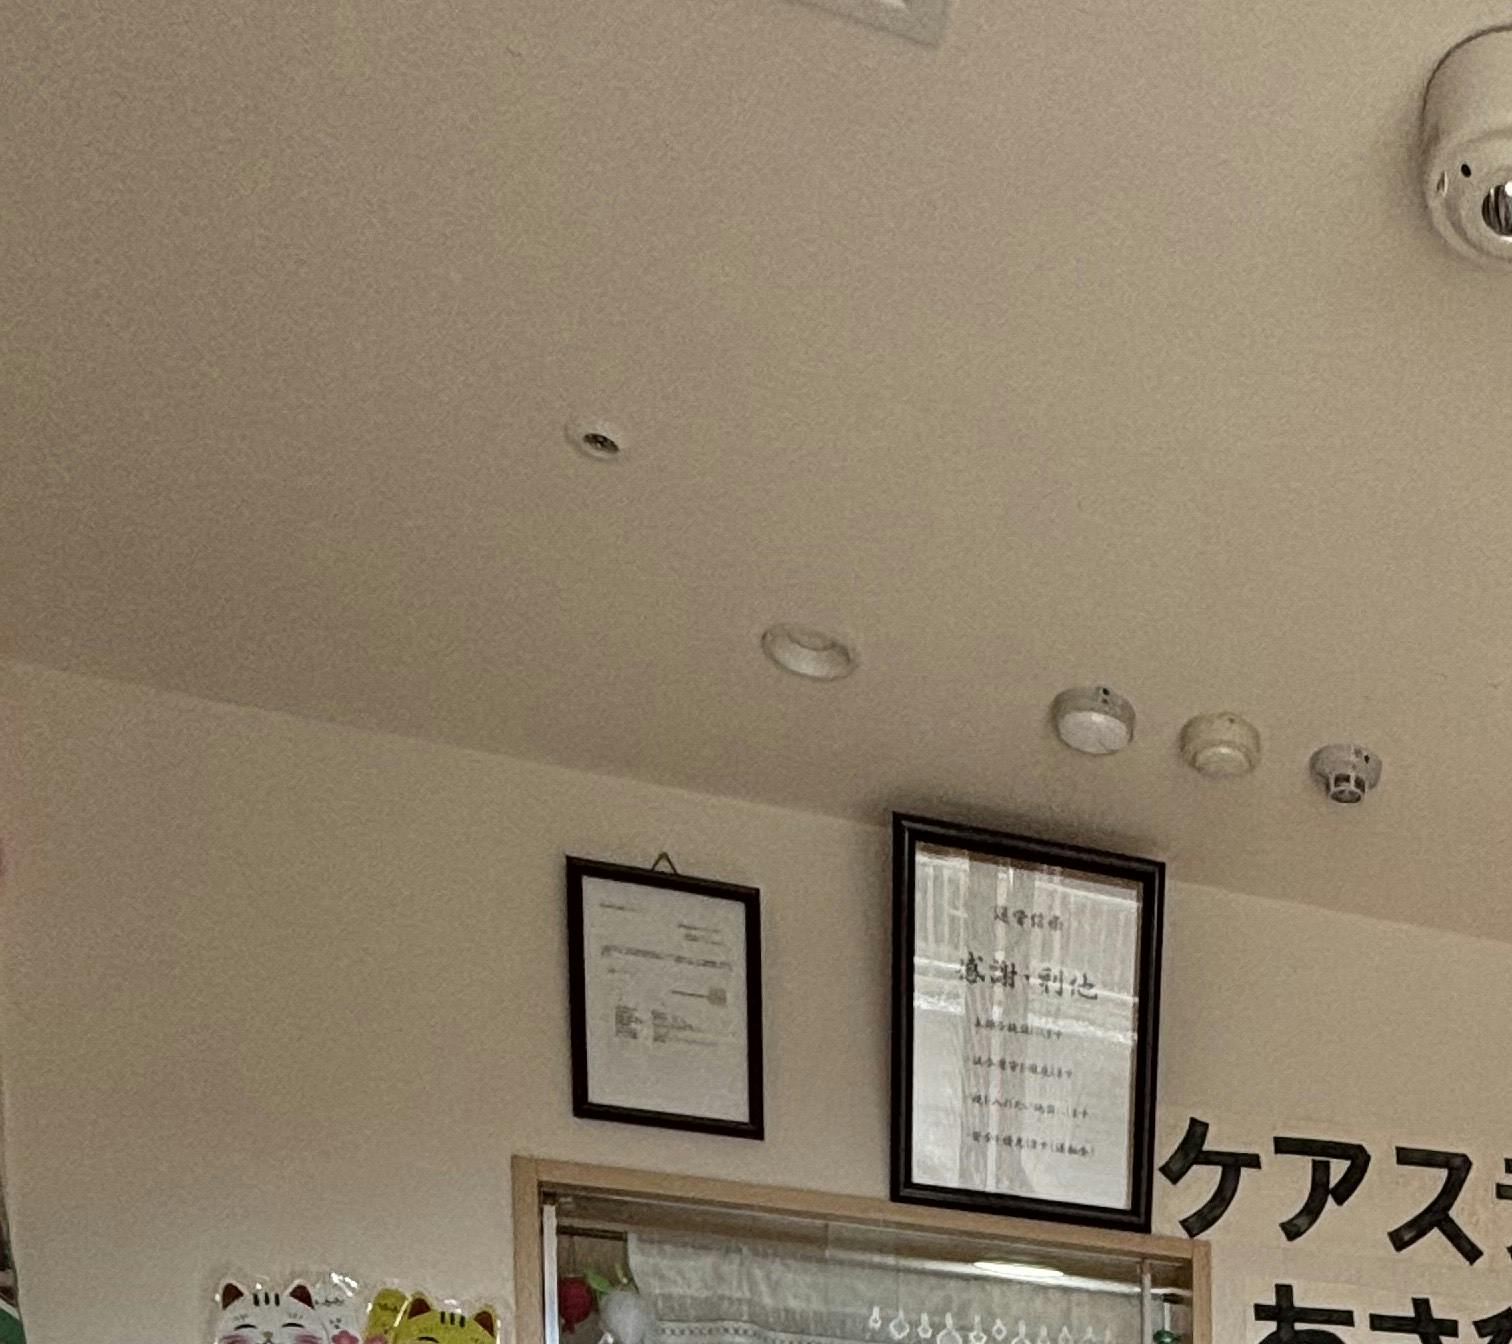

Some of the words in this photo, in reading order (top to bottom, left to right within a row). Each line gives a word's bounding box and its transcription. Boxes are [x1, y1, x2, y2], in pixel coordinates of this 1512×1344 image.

[959, 950, 1098, 1000] 感謝・利他
